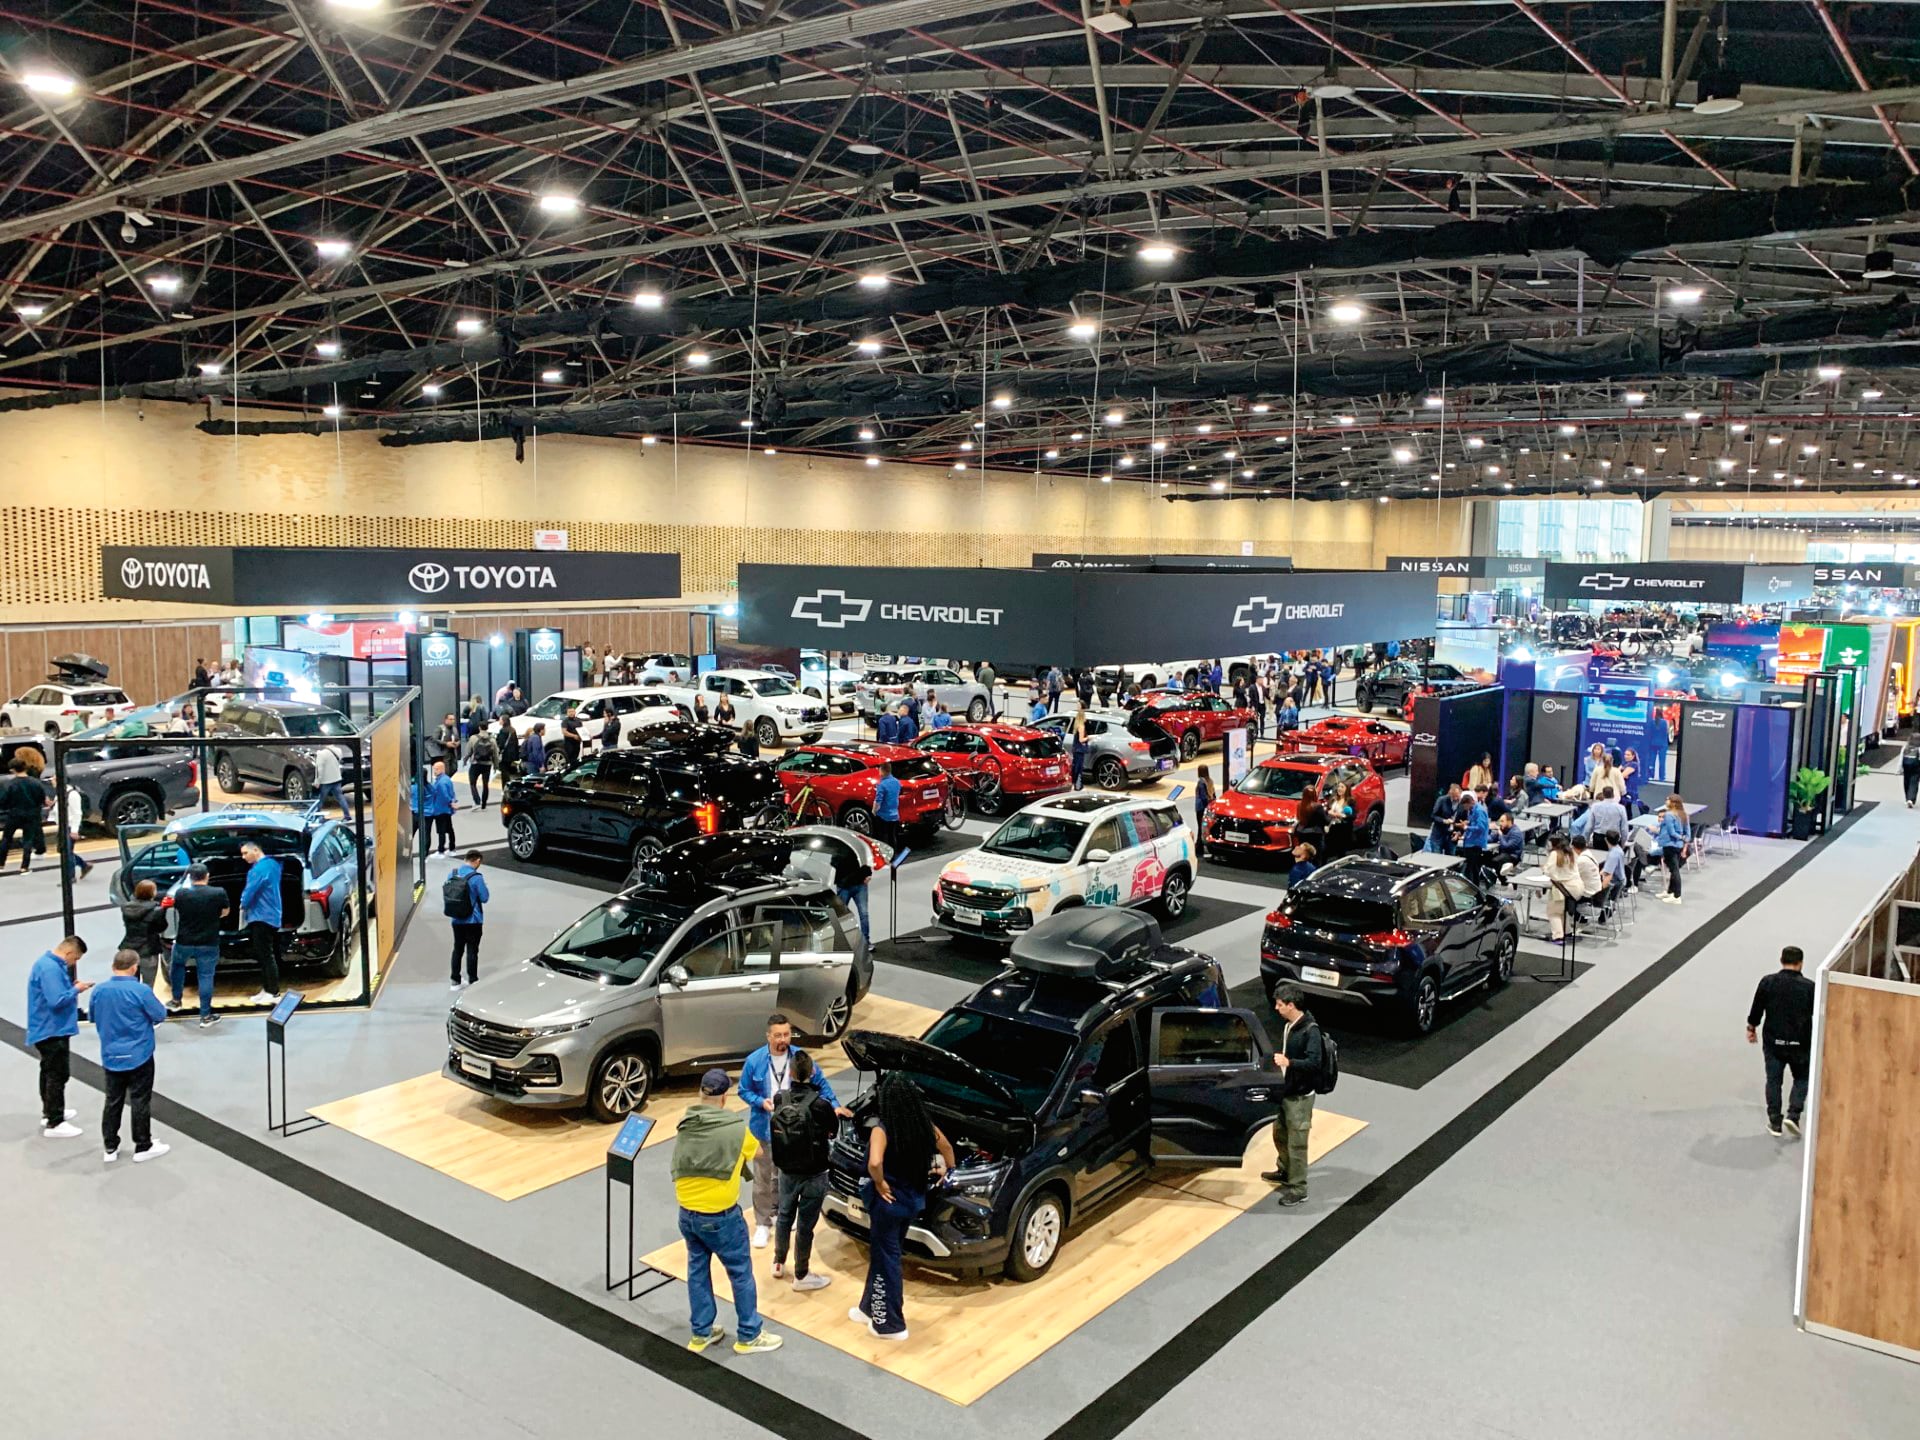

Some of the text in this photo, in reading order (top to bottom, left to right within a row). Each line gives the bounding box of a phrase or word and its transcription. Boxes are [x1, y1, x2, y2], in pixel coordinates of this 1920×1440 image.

[1401, 562, 1469, 573] NISSAN
[1508, 563, 1532, 573] NISSAN
[145, 561, 211, 589] TOYOTA
[453, 566, 557, 589] TOYOTA
[1815, 569, 1882, 582] SSAN
[1633, 579, 1706, 588] CHEVROLET
[879, 603, 1004, 626] CHEVROLET
[1285, 602, 1345, 620] CHEVROLET
[424, 659, 453, 667] TOYOTA
[532, 653, 558, 661] TOYOTA
